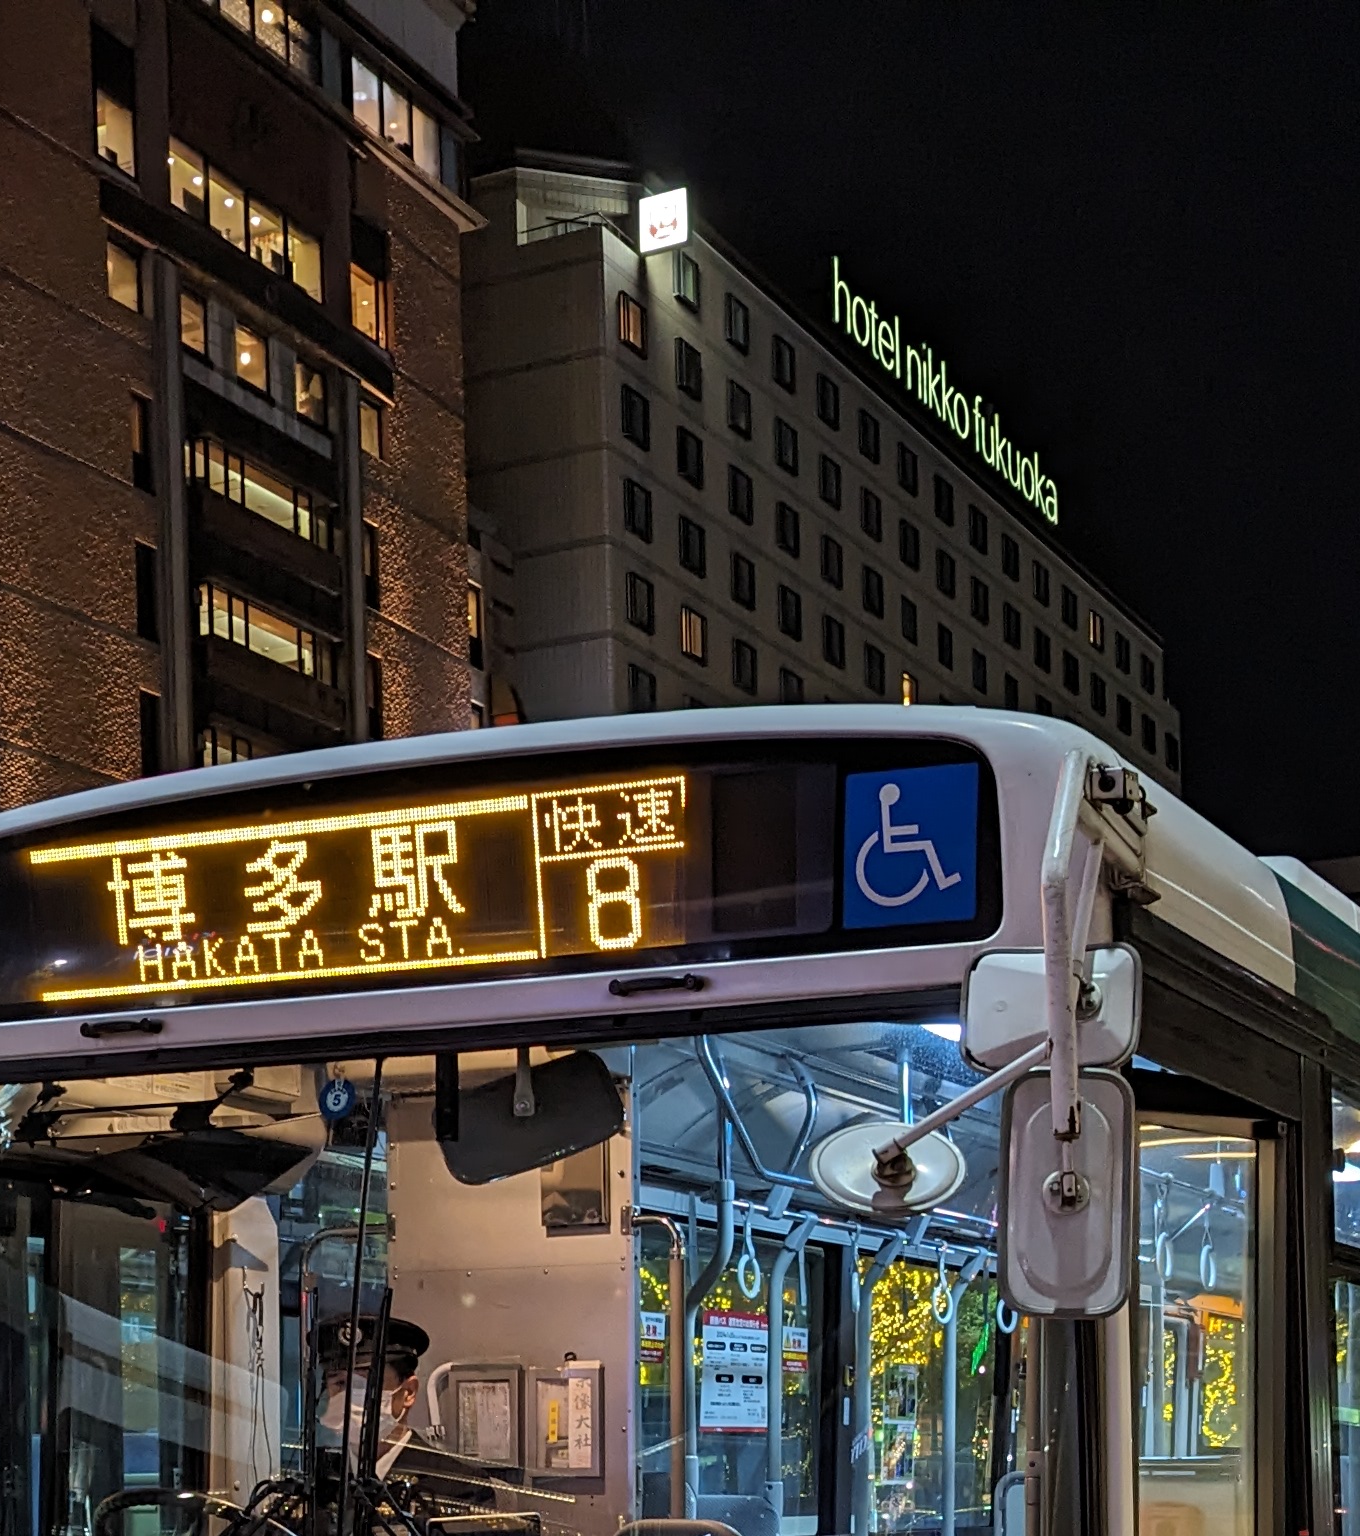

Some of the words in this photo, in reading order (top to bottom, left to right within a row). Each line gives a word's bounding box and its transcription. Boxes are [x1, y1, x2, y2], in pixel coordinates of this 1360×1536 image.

[831, 255, 901, 380] hotel
[906, 340, 970, 438] nikko
[972, 394, 1059, 526] fukuoka
[544, 782, 681, 855] 快速
[106, 818, 465, 947] 博多駅
[585, 855, 644, 952] 8
[138, 929, 325, 984] HAKATA
[357, 917, 466, 967] STA.
[332, 1094, 342, 1107] 5
